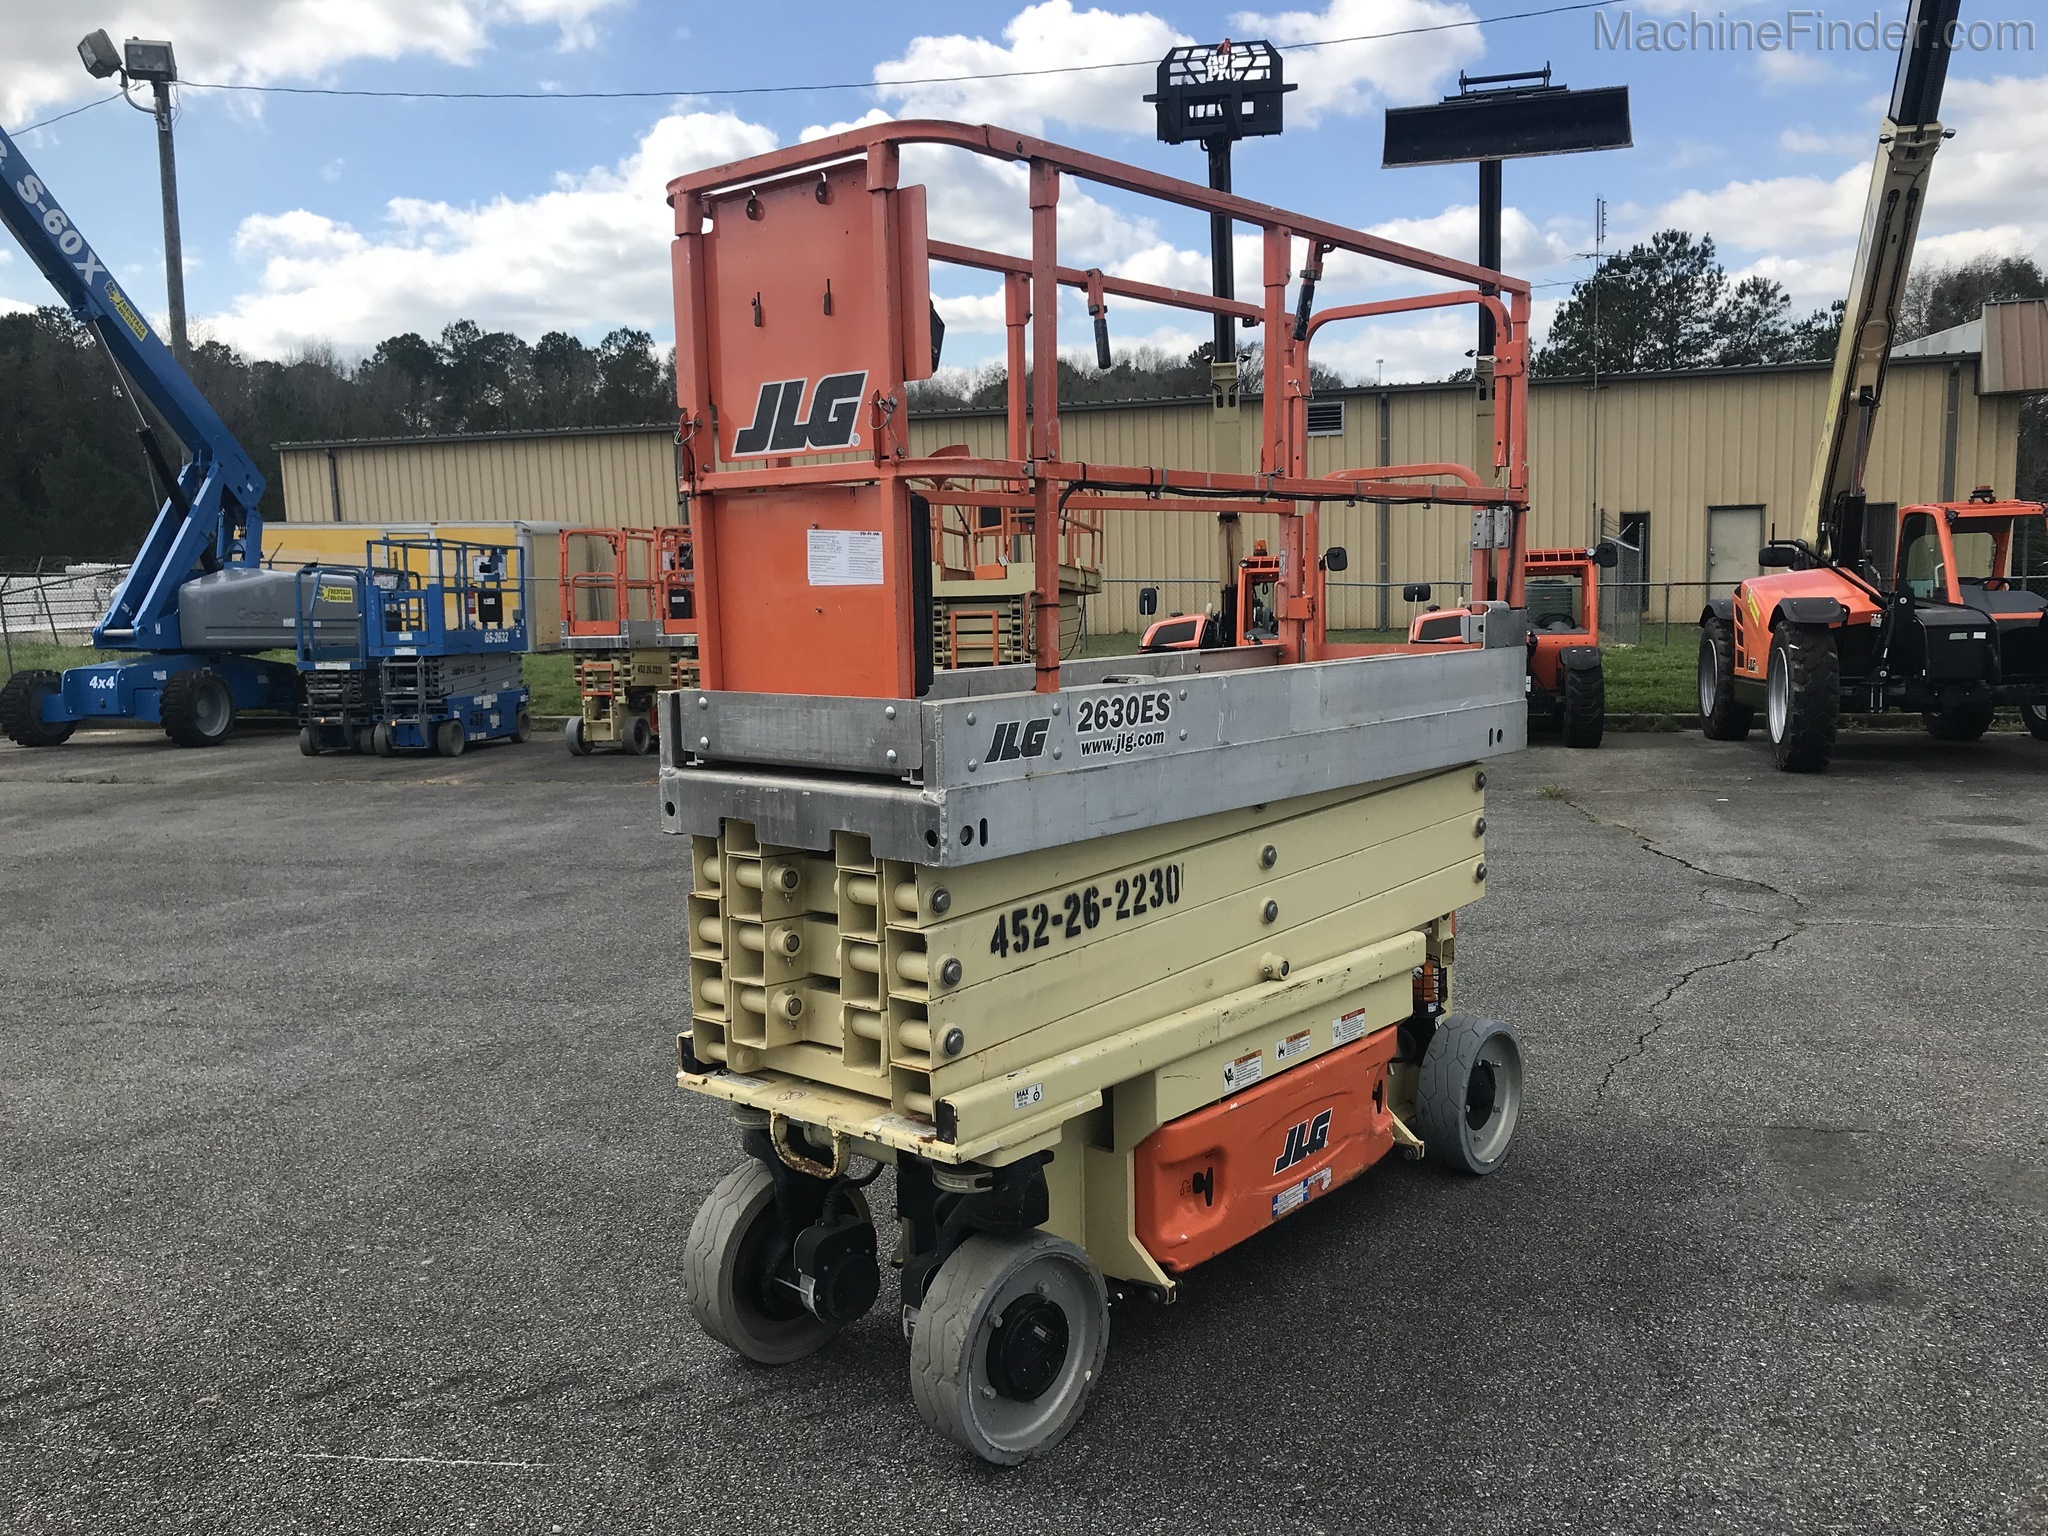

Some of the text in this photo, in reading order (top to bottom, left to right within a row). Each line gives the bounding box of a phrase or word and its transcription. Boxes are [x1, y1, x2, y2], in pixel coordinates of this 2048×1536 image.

[121, 302, 147, 334] RENTALS
[731, 370, 869, 457] JLG
[484, 632, 509, 643] GS-2632
[89, 675, 116, 689] 4x4
[984, 691, 1172, 764] JLG 2630ES
[1080, 730, 1166, 757] www.jlg.com
[990, 863, 1181, 959] 452-26-2230
[1016, 1089, 1029, 1099] MAX
[1272, 1107, 1334, 1176] JLG
